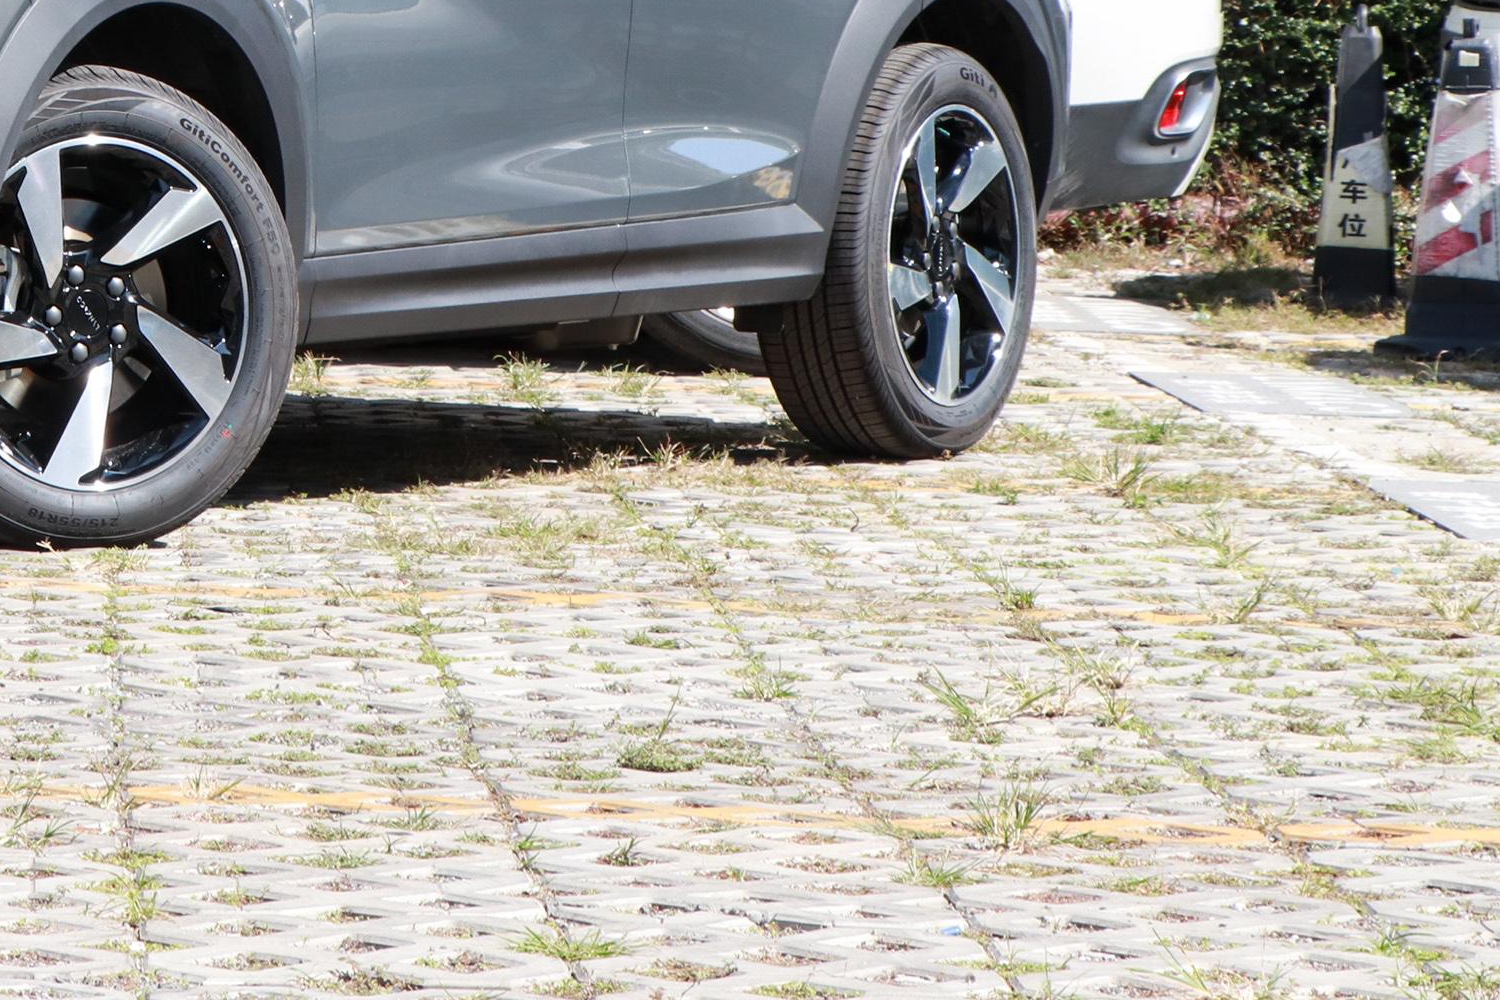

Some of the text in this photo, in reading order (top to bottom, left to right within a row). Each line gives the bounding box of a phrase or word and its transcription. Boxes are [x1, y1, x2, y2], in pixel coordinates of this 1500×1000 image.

[960, 66, 985, 87] Giti
[179, 118, 264, 213] GitiComfort
[1338, 158, 1368, 238] 车位
[27, 507, 120, 529] 215/55R18
